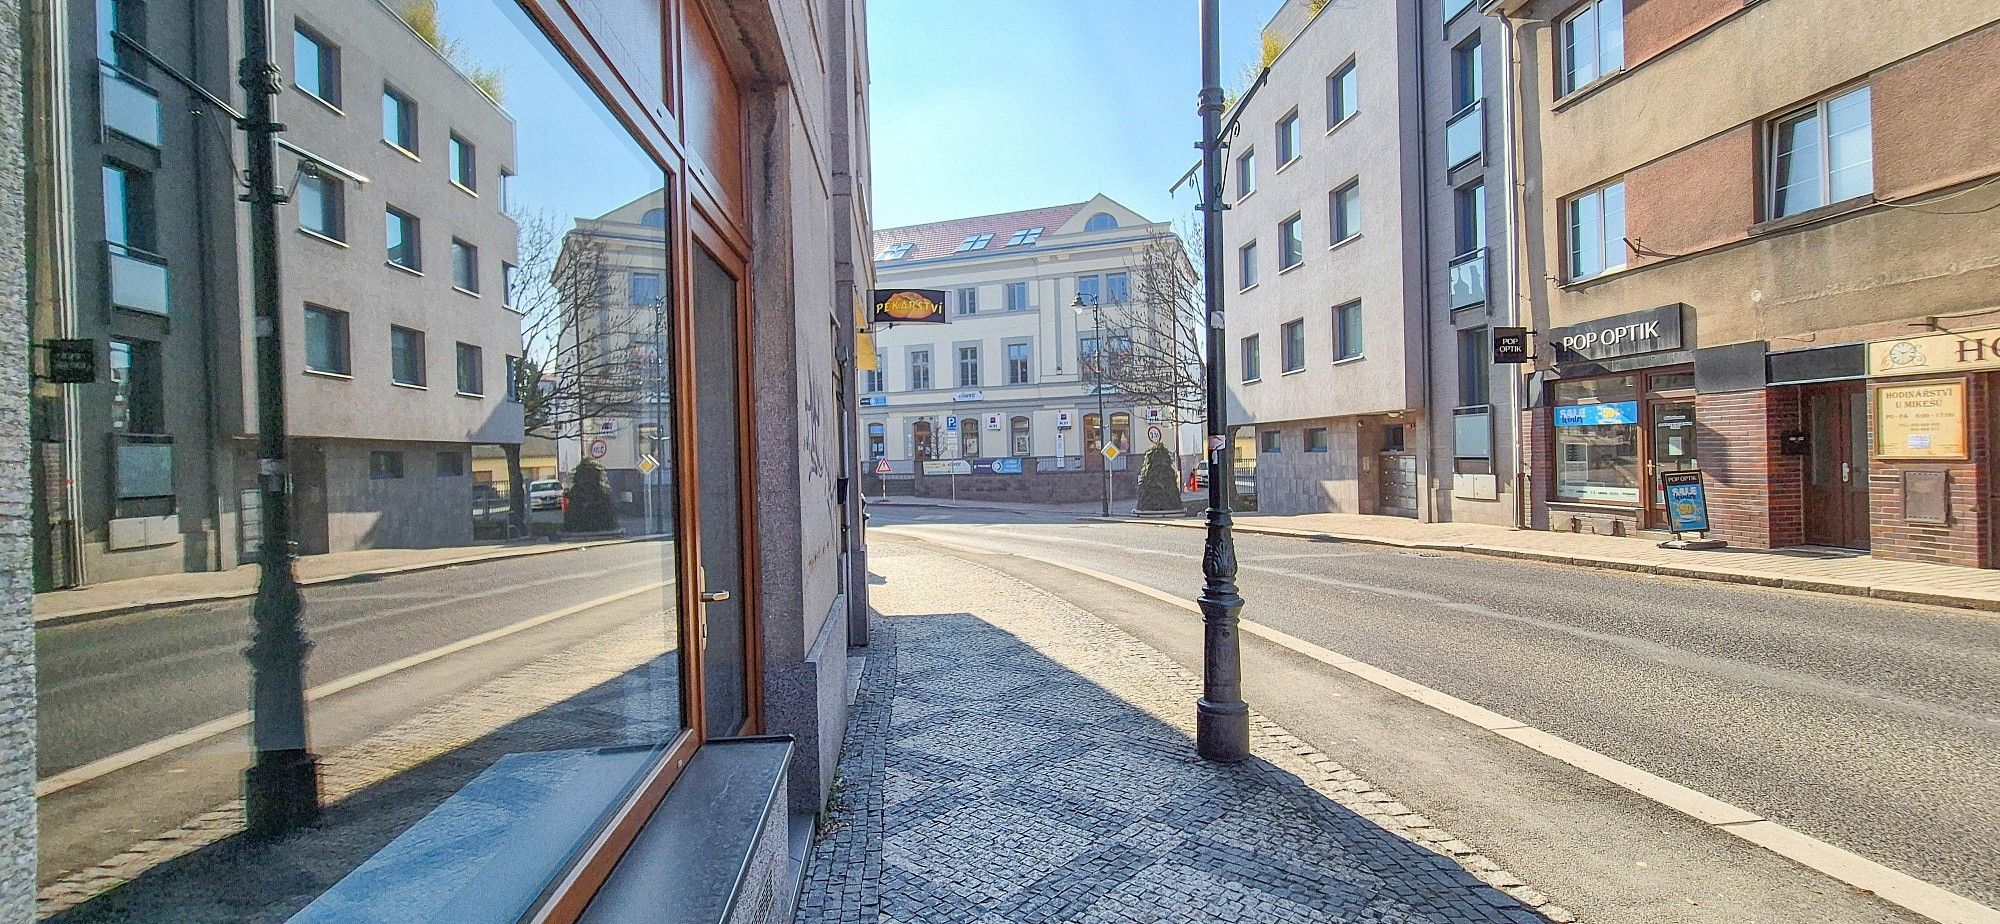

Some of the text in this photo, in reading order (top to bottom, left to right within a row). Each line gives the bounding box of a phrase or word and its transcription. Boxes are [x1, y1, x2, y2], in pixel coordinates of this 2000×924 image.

[1563, 320, 1660, 352] POP OPTIK
[1499, 345, 1522, 353] OPTIK
